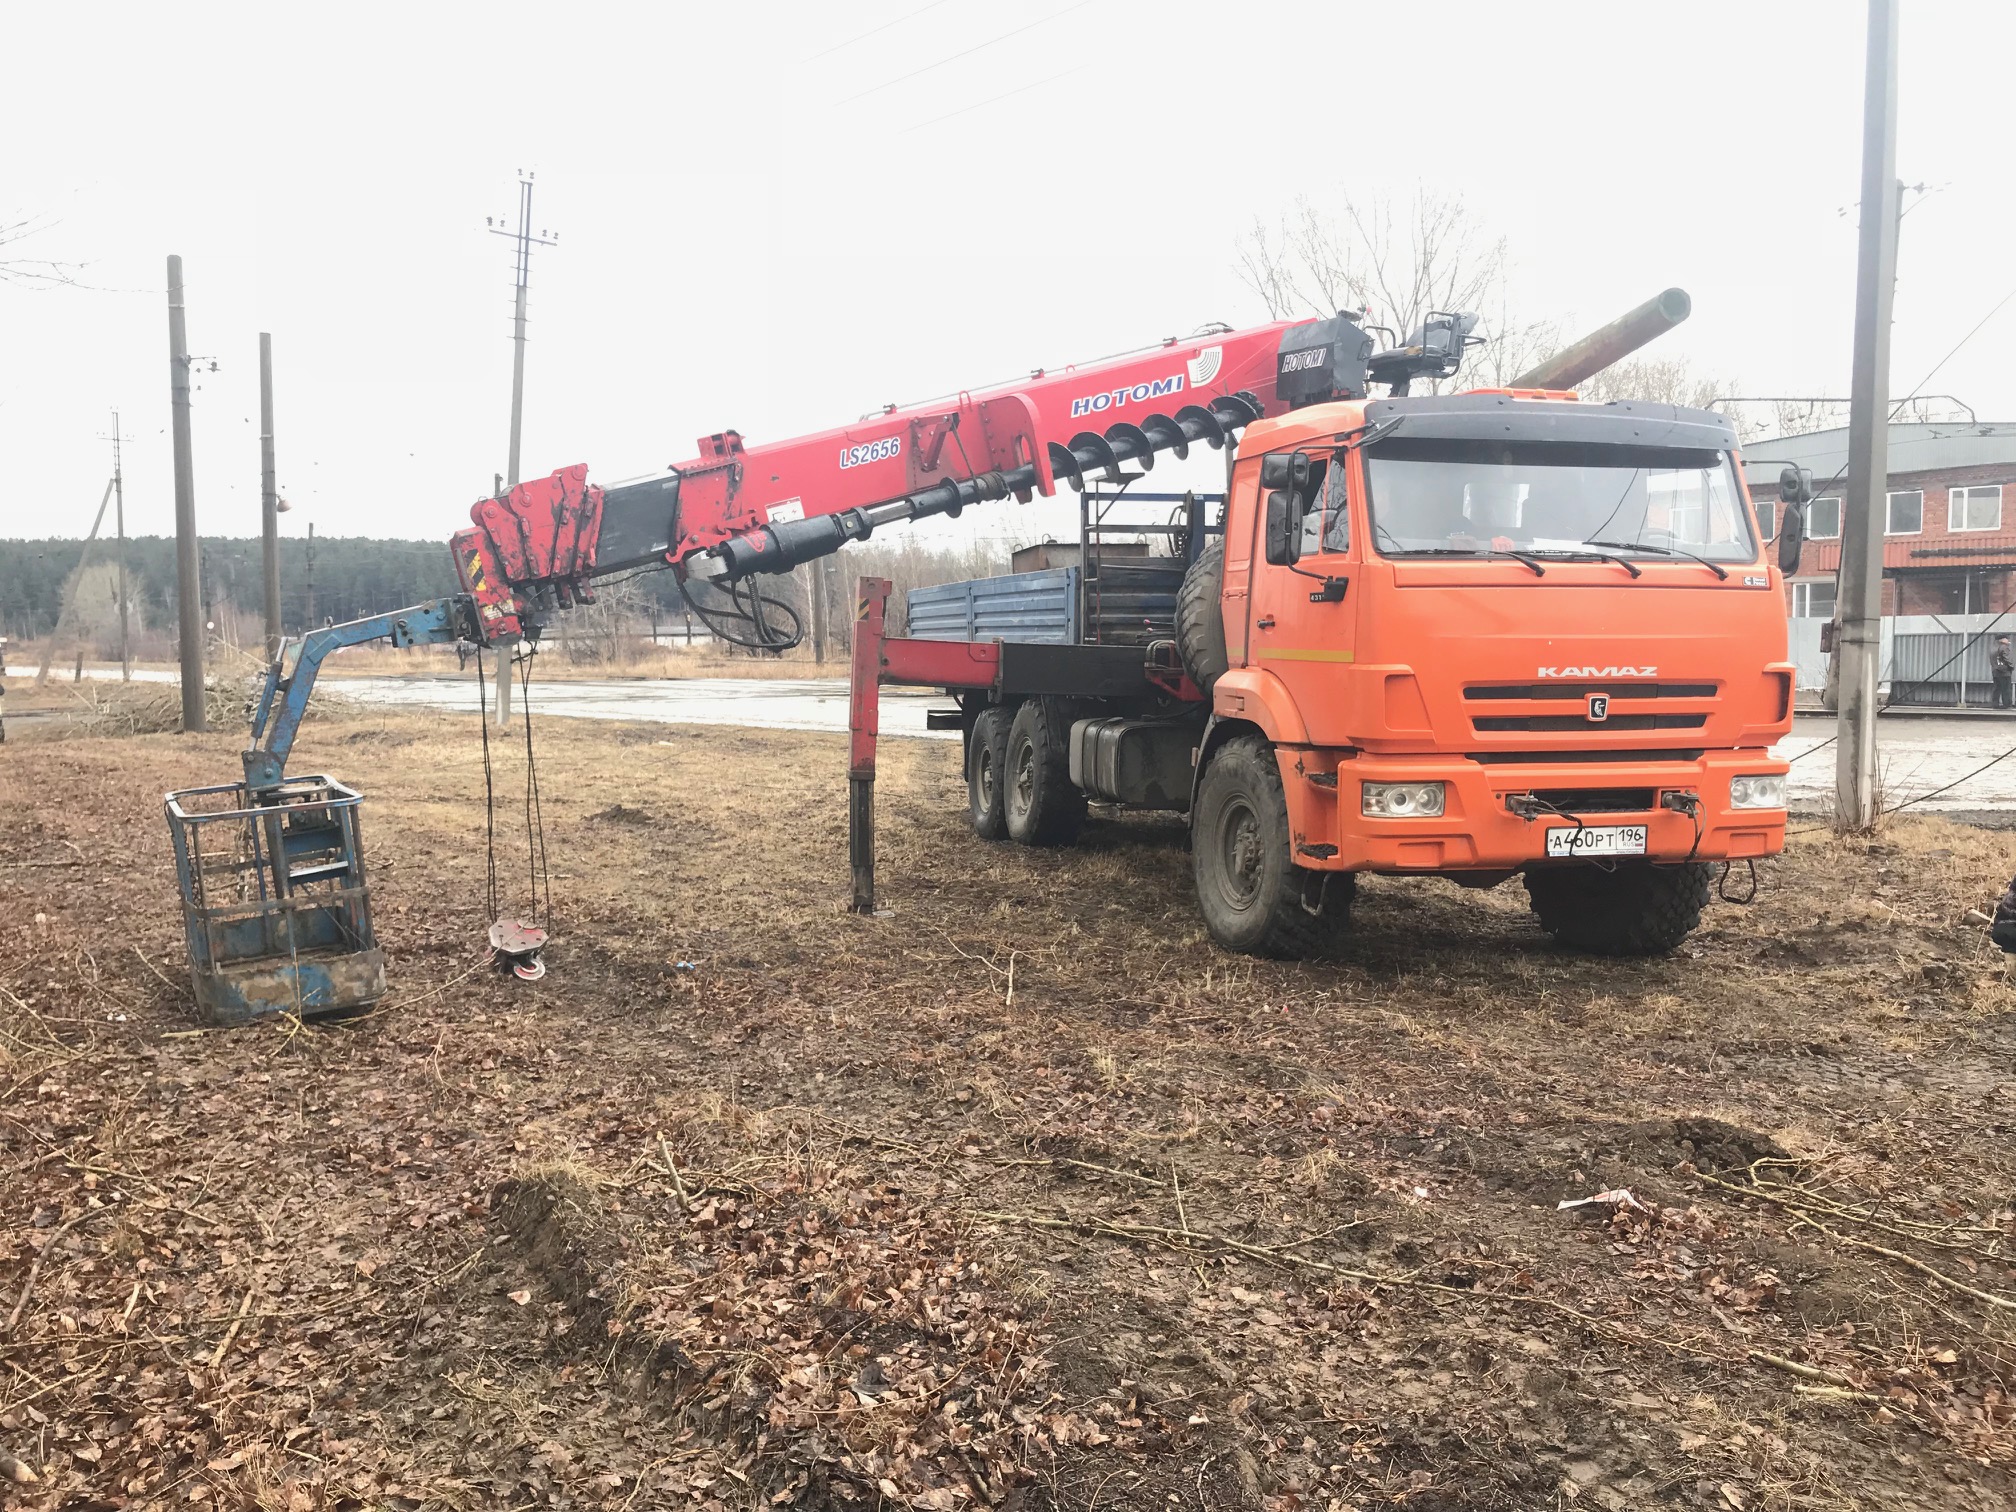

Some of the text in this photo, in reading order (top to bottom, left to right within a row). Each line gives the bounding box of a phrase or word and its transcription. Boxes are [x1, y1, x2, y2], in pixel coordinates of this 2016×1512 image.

[1281, 348, 1327, 373] HOTOMI
[1071, 374, 1184, 418] HOTOMI
[840, 437, 900, 469] LS2656
[1538, 666, 1657, 678] KAMAZ
[1618, 828, 1643, 842] 196
